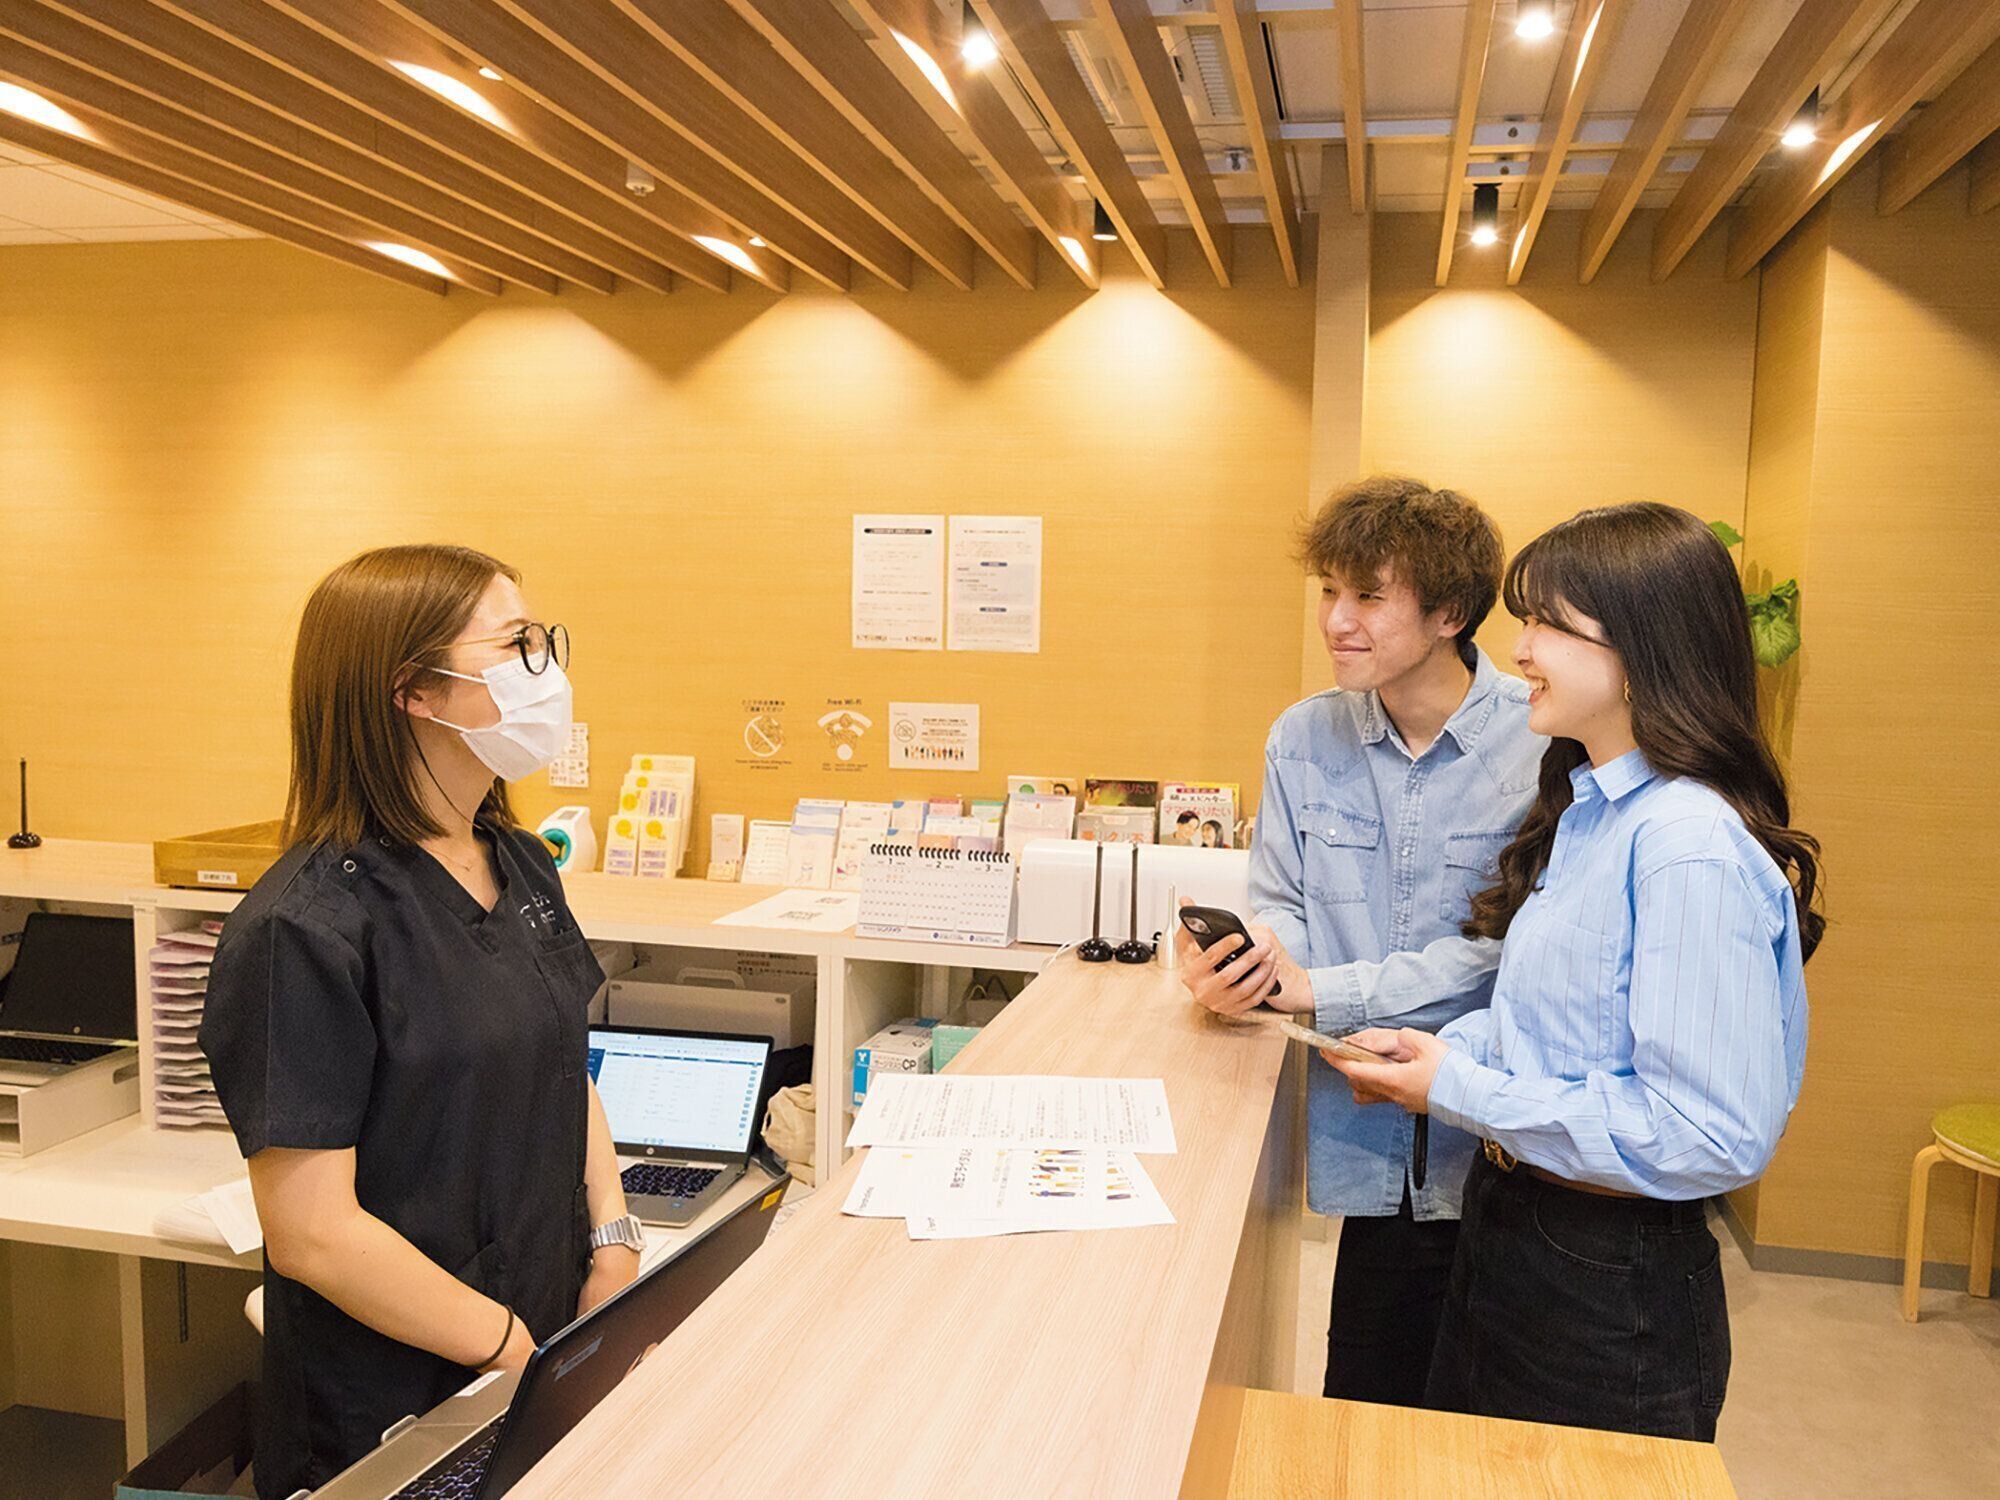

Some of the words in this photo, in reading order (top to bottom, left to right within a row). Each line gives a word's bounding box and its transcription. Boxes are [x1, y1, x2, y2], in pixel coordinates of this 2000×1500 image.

[935, 861, 942, 869] 2
[985, 864, 992, 873] 3
[902, 1058, 917, 1070] CP
